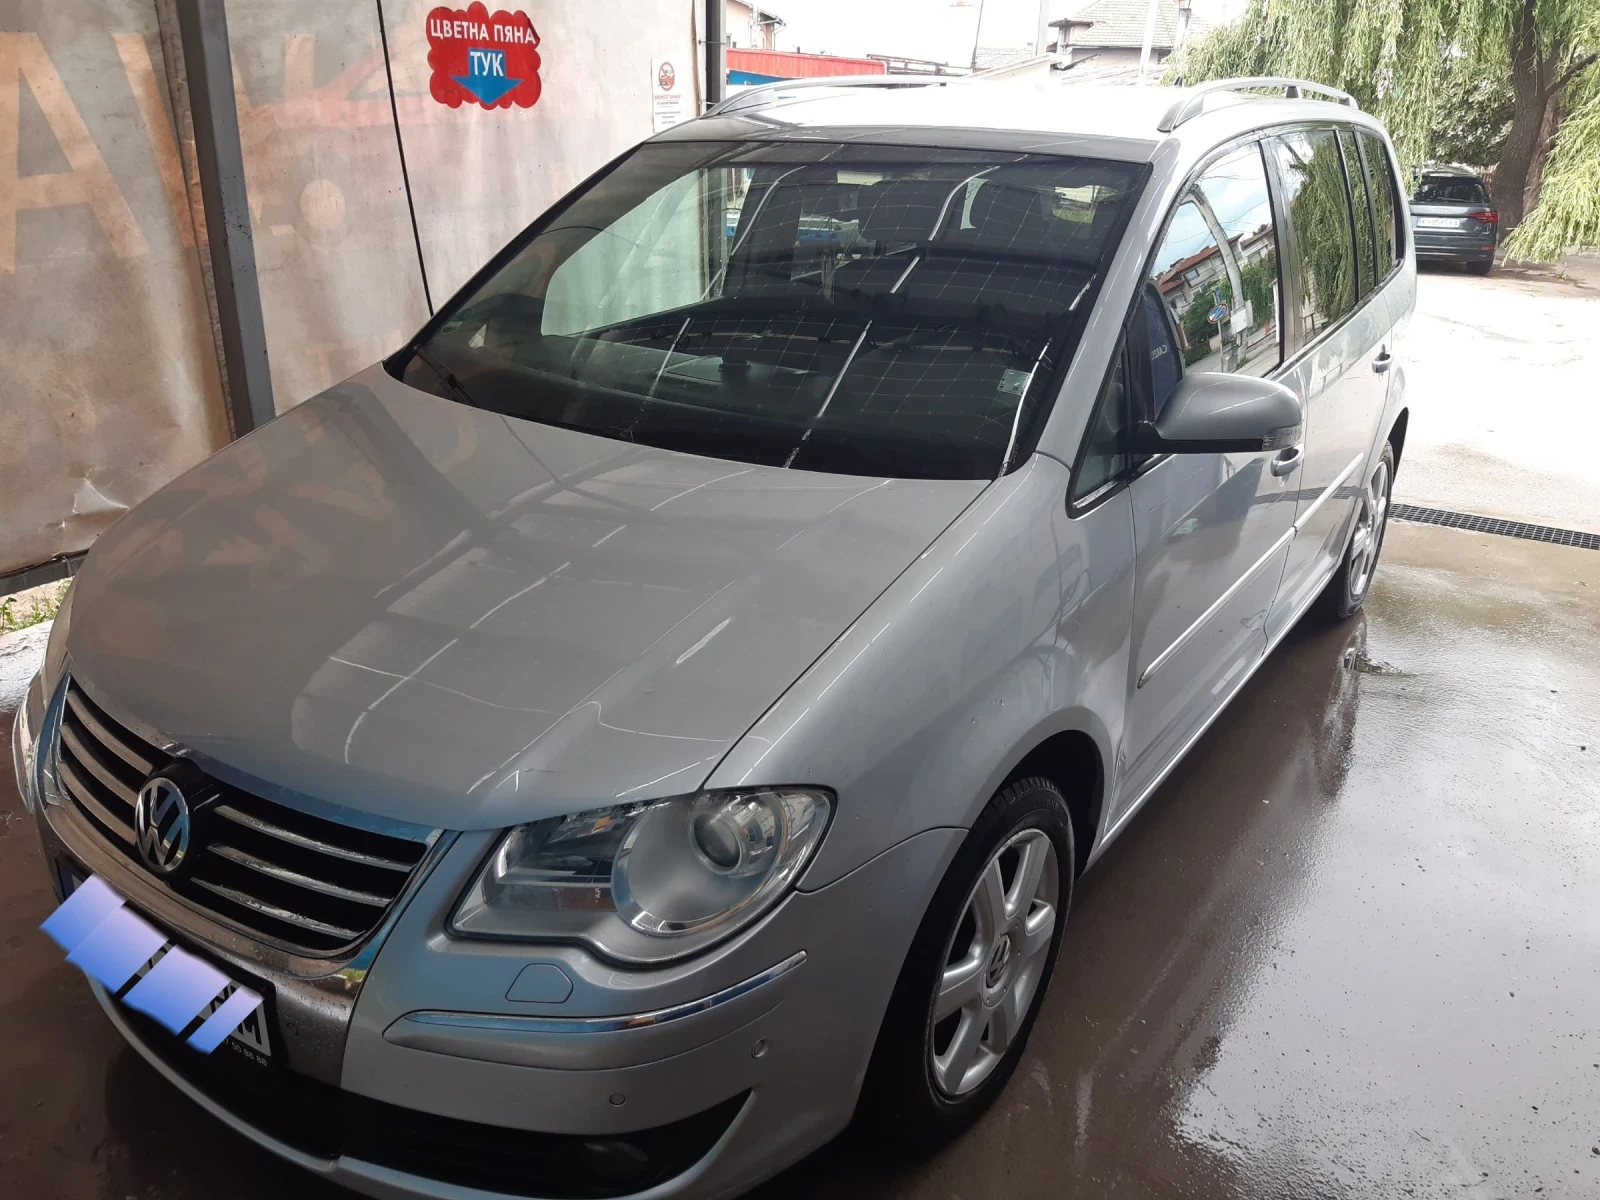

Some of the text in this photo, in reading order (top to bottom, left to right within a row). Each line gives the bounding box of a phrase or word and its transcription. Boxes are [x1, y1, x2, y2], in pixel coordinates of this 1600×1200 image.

[430, 19, 536, 44] ЦВЕТНА ПЯНА
[470, 51, 504, 76] ТУК
